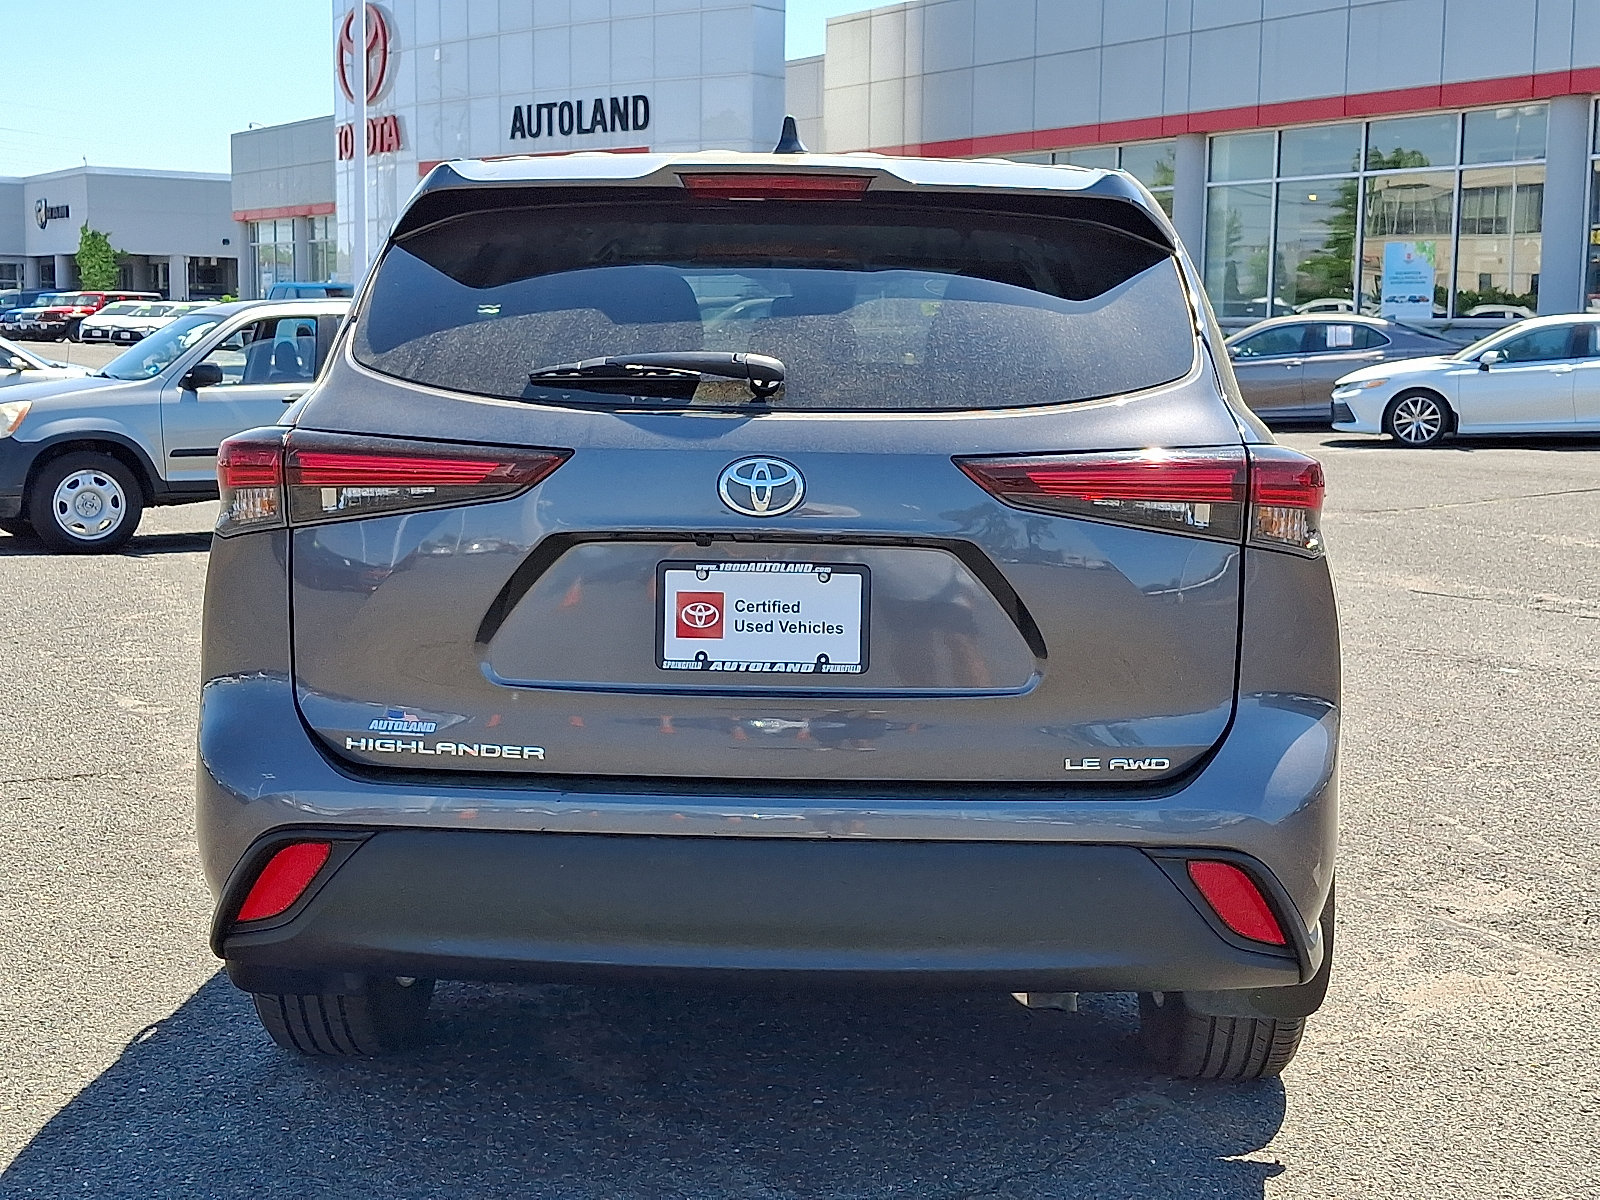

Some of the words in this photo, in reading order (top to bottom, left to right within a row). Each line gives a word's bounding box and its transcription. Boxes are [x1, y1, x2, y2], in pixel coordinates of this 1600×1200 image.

[509, 94, 650, 140] AUTOLAND
[335, 114, 401, 160] TOOTA
[734, 599, 801, 614] Certified
[734, 619, 774, 633] Used
[779, 620, 844, 635] Vehicles
[709, 661, 815, 673] AUTOLAND
[368, 719, 437, 732] AUTOLAND
[345, 736, 545, 760] HIGHLANDER
[1065, 758, 1101, 770] LE
[1109, 758, 1170, 770] AWD
